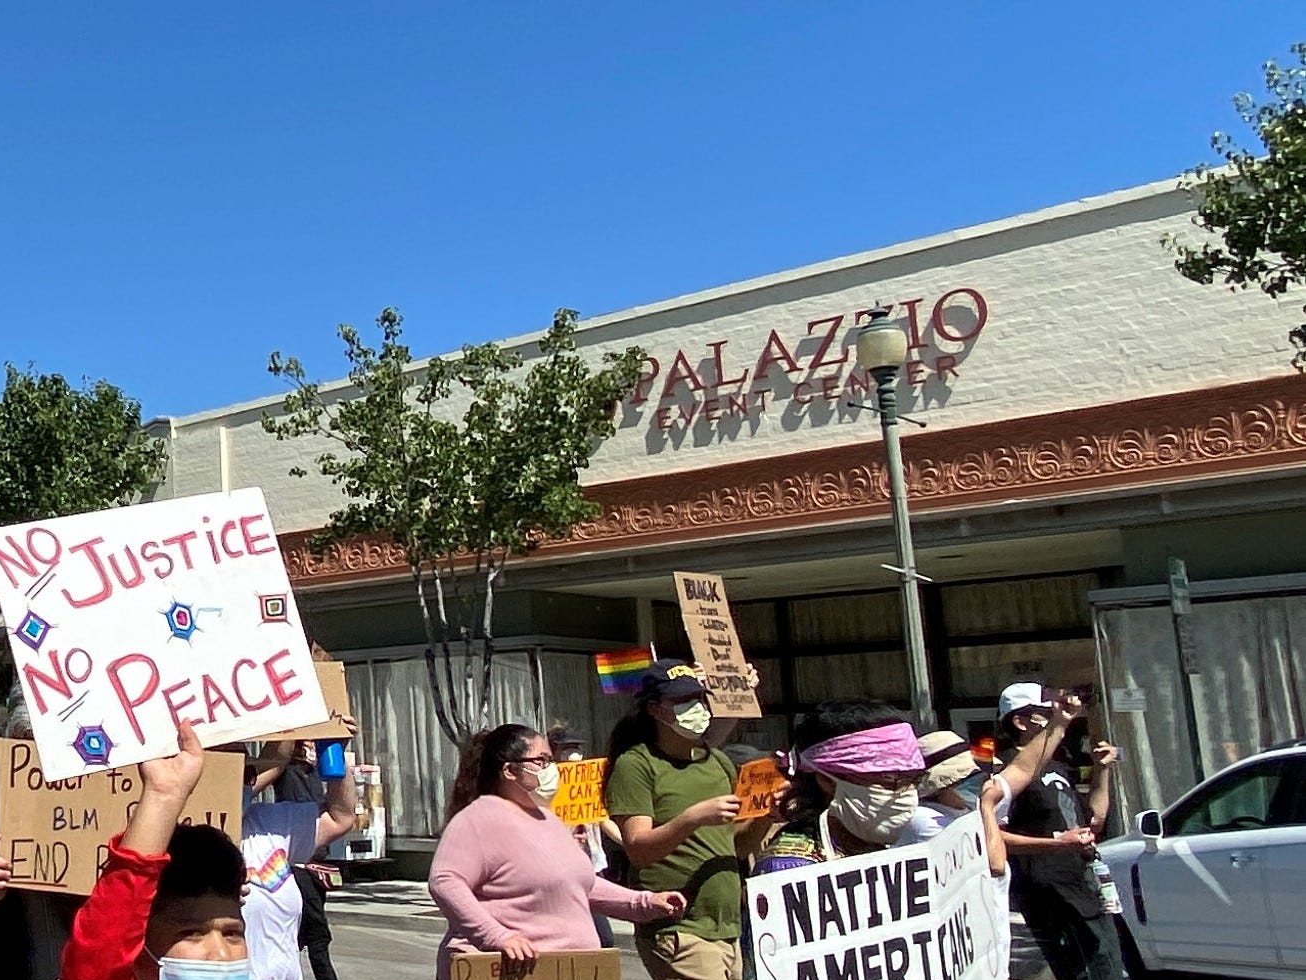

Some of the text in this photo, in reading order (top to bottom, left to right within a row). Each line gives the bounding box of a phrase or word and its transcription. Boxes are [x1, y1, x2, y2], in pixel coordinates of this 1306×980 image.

[657, 354, 961, 430] EVENT CENER
[61, 513, 277, 609] JUSTICE
[22, 646, 303, 747] NO PEACE
[52, 806, 99, 831] BLM
[106, 768, 134, 794] to
[9, 839, 69, 884] END
[781, 857, 931, 947] NATIVE
